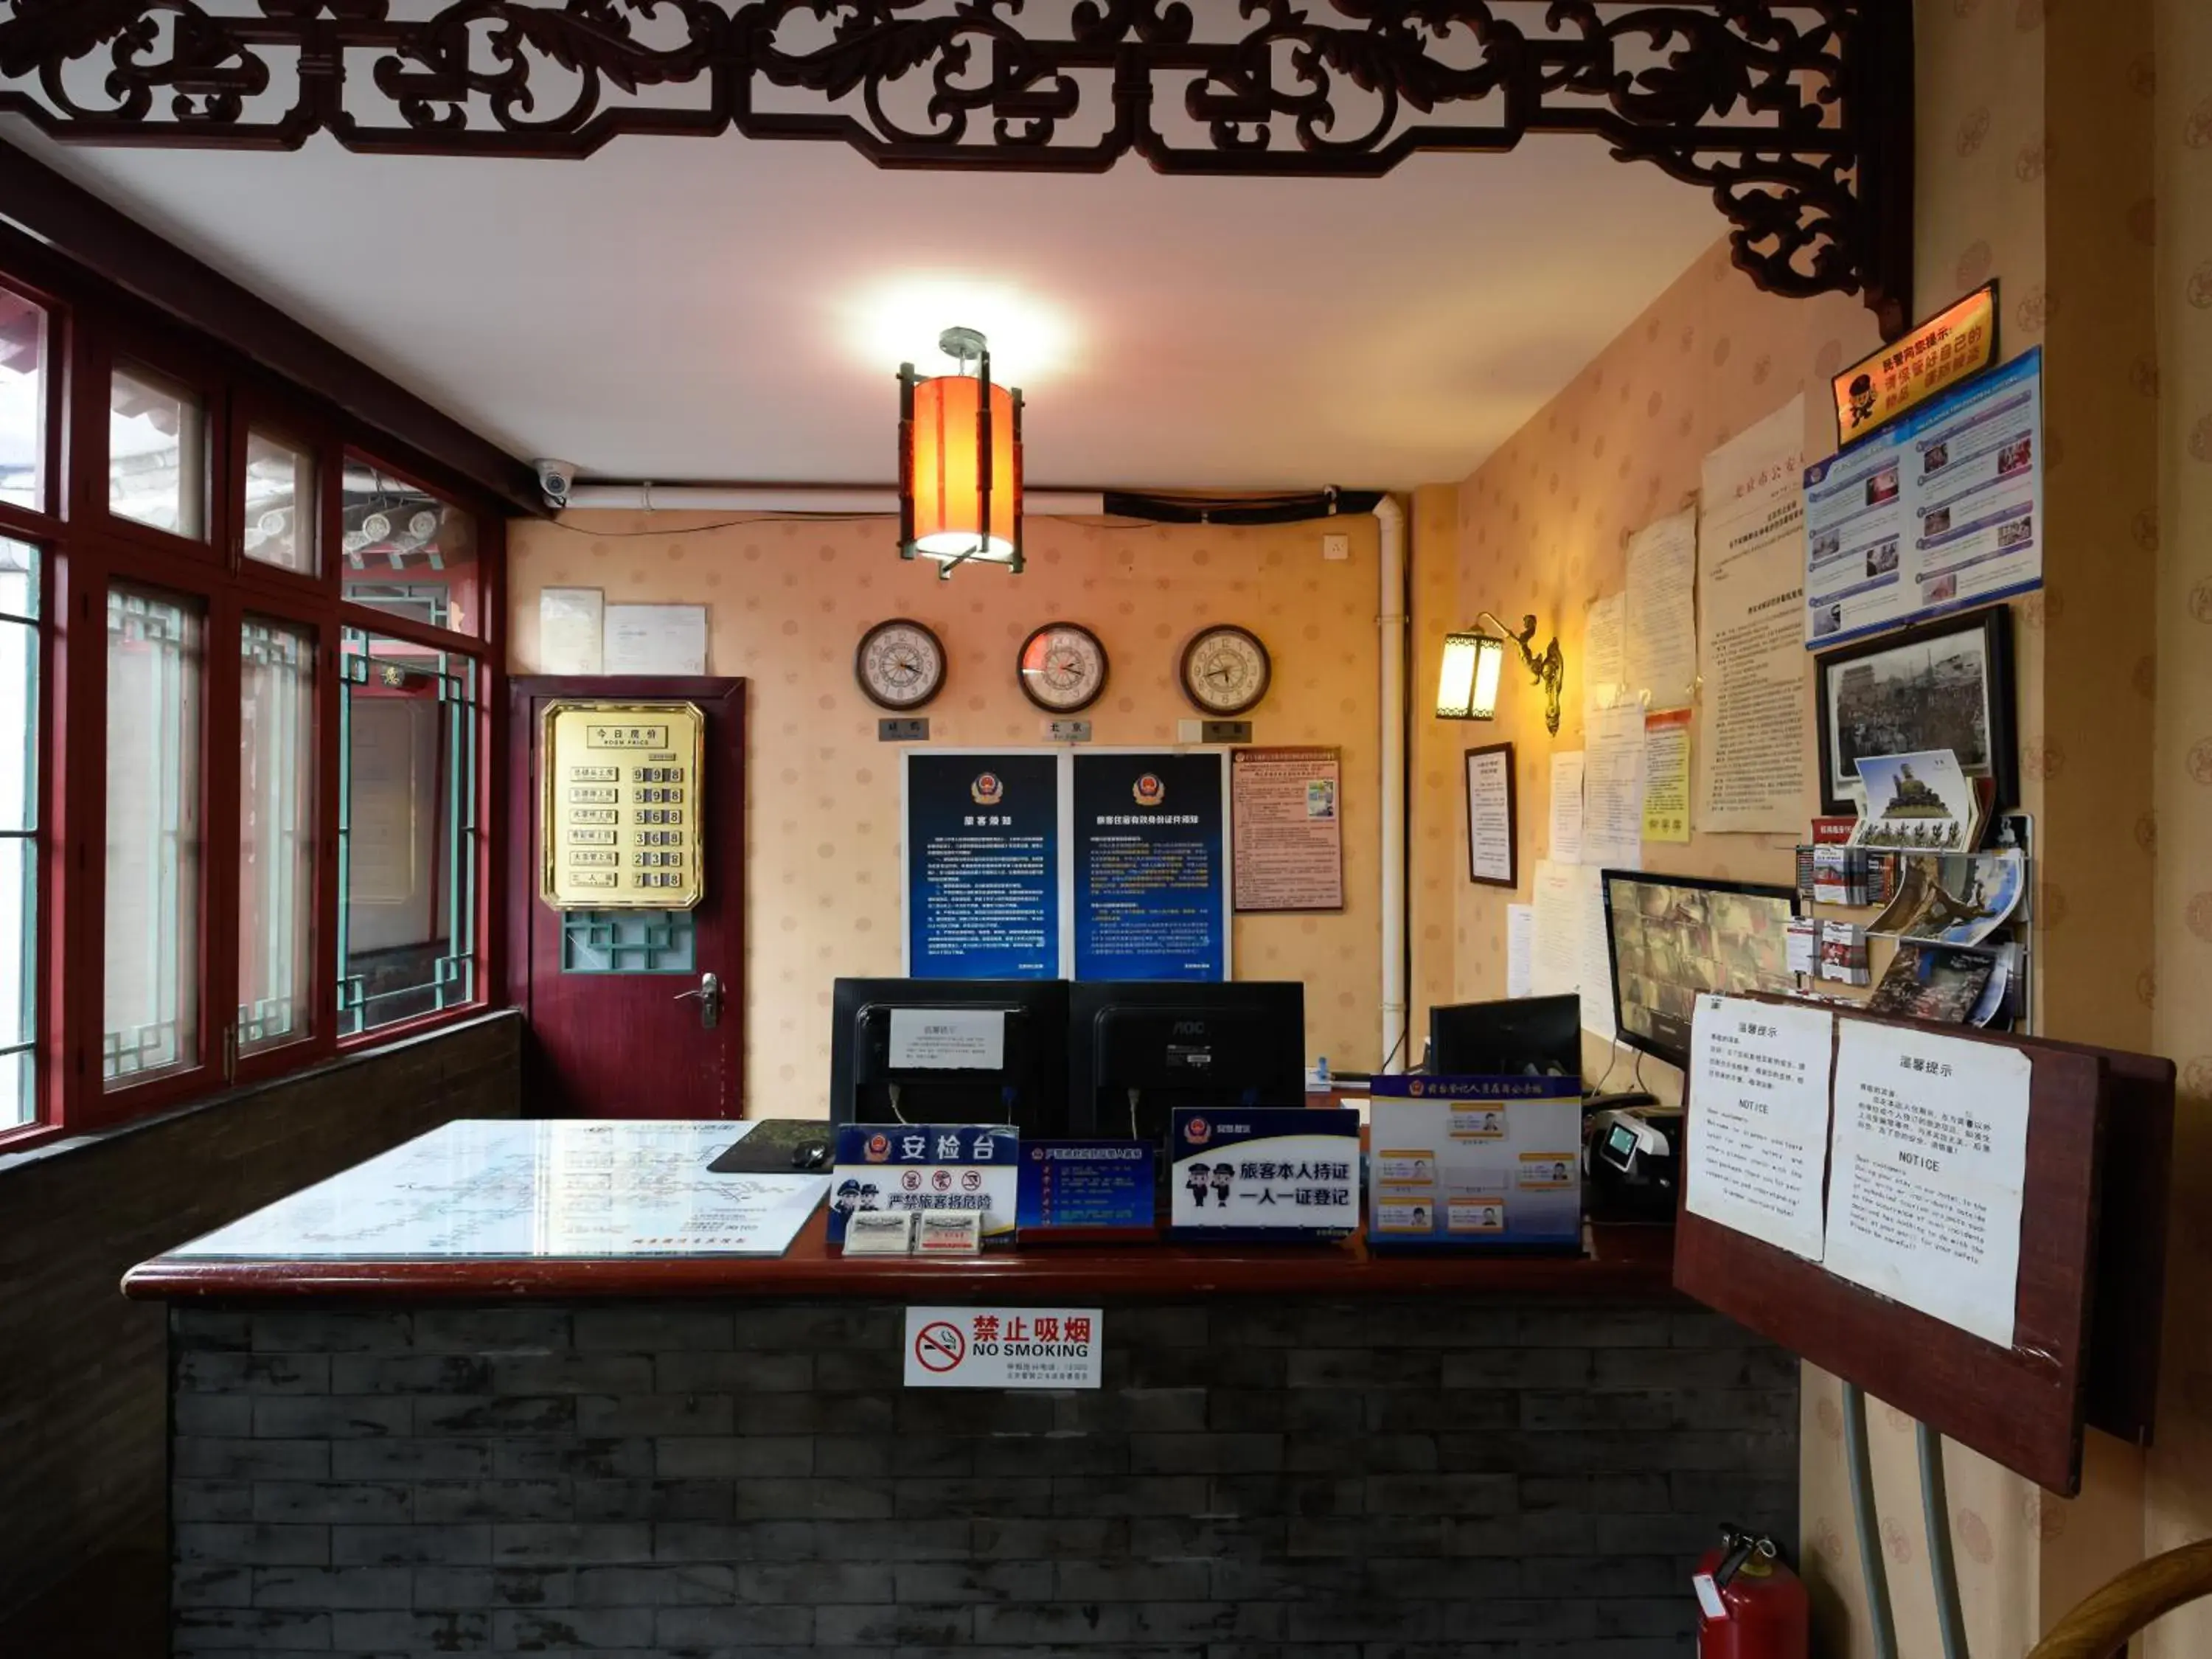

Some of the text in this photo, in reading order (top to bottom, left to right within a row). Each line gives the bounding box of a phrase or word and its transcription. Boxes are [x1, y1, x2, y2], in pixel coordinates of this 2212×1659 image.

[1738, 1022, 1778, 1038] 温馨提示
[1899, 1055, 1953, 1078] 温馨提示
[1739, 1099, 1769, 1115] NOTICE
[900, 1134, 995, 1160] 安检台
[1239, 1161, 1350, 1180] 旅客本人持证
[1899, 1152, 1941, 1172] NOTICE
[1239, 1188, 1349, 1206] 一人一证登记
[973, 1315, 1091, 1343] 禁止吸烟
[973, 1344, 1088, 1357] NO SMOKING
